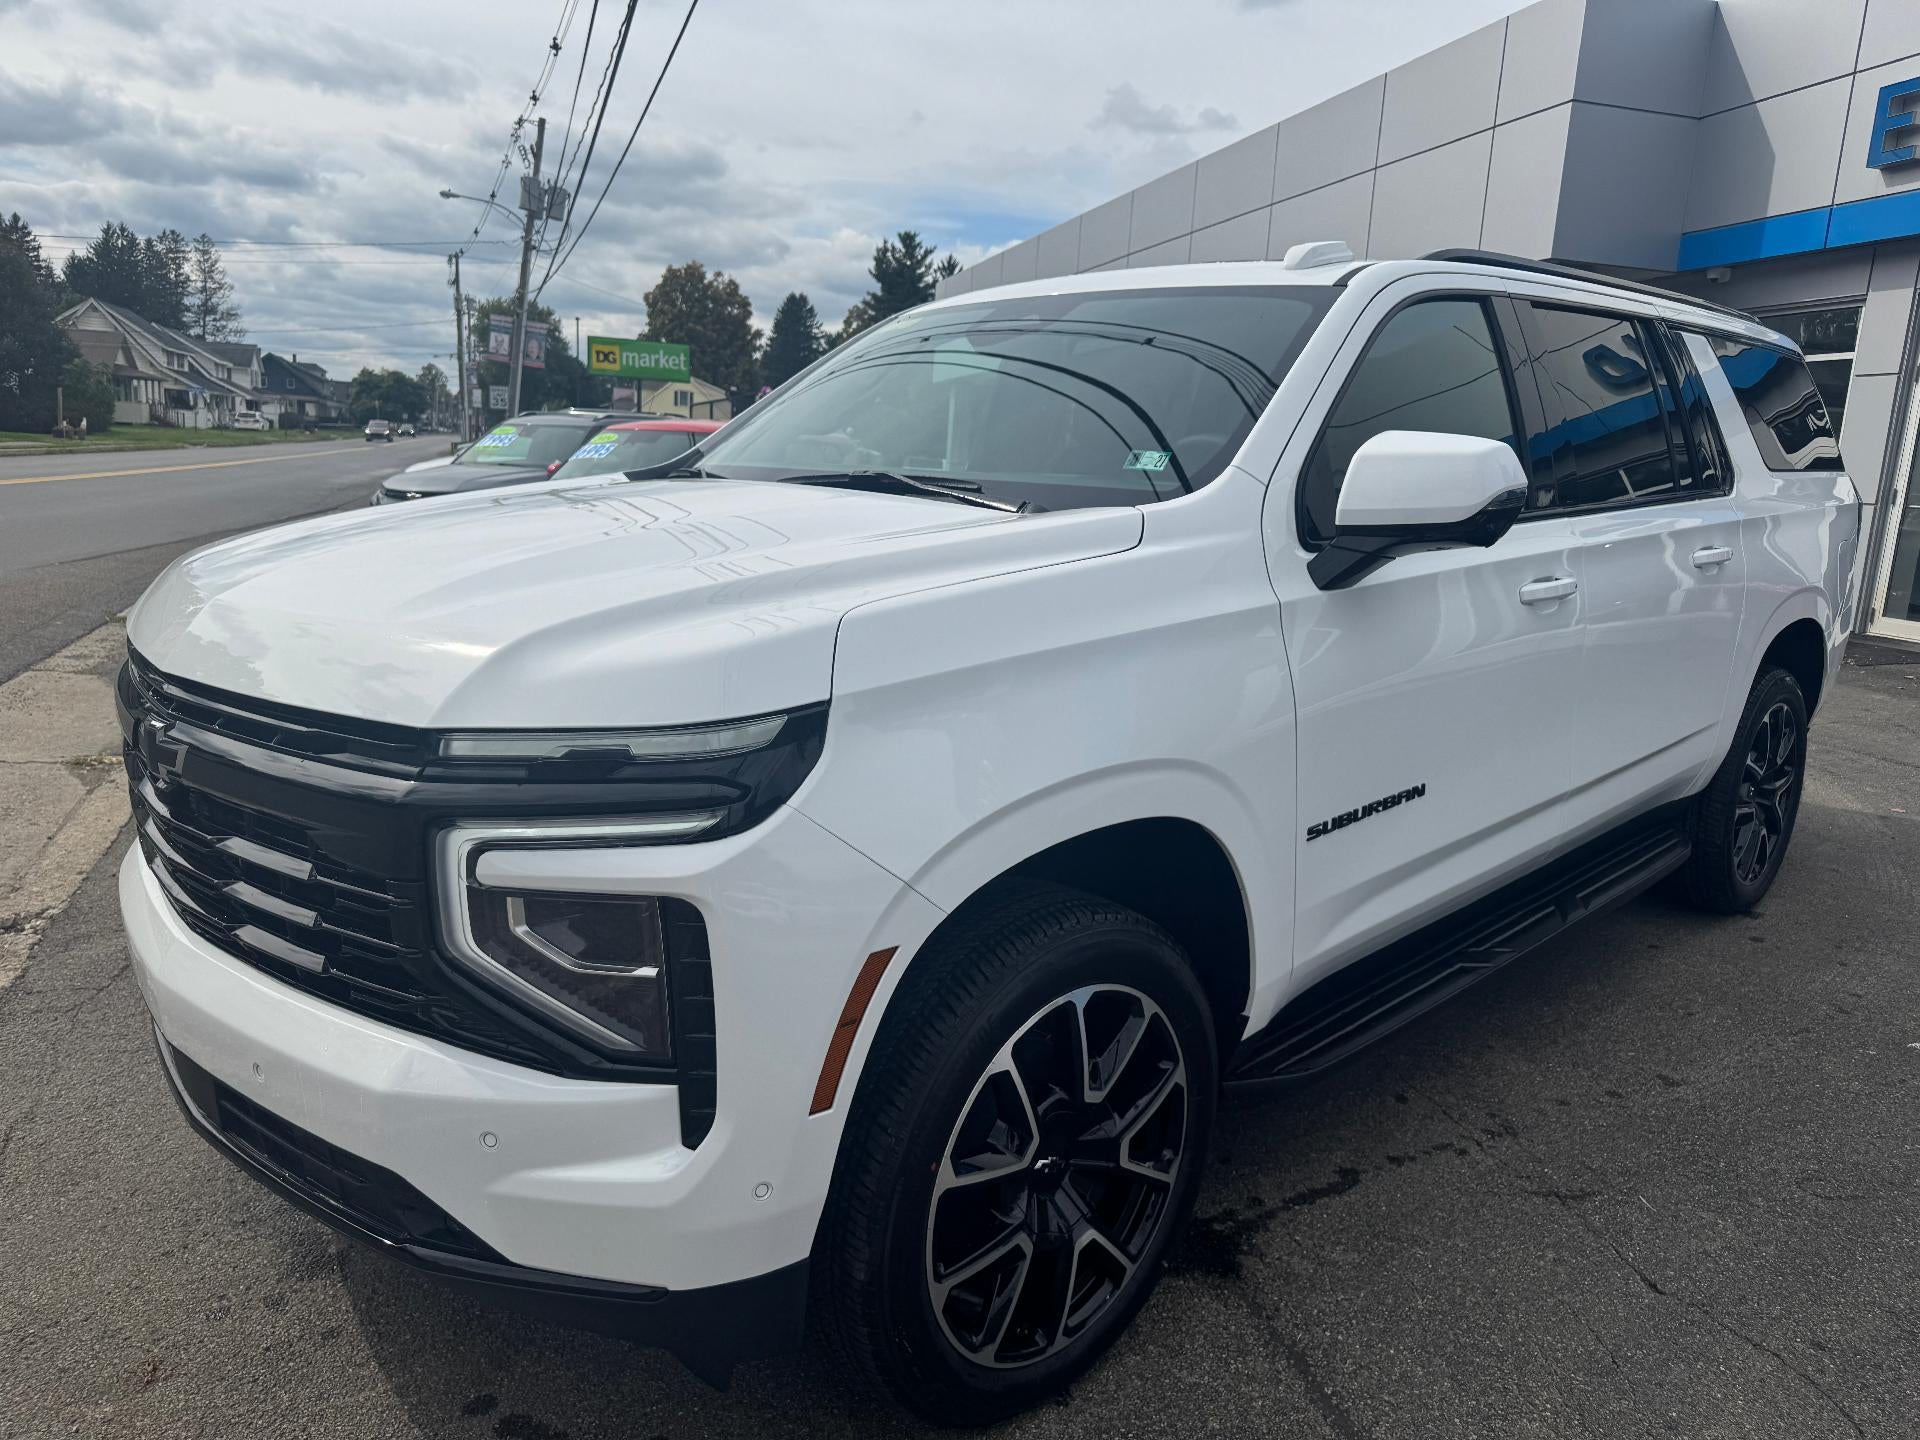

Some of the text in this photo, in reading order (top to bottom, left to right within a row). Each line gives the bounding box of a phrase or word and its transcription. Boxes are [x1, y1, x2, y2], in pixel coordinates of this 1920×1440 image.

[595, 349, 687, 370] DG market
[1153, 454, 1168, 468] 27
[1306, 783, 1426, 842] SUBURBAN
